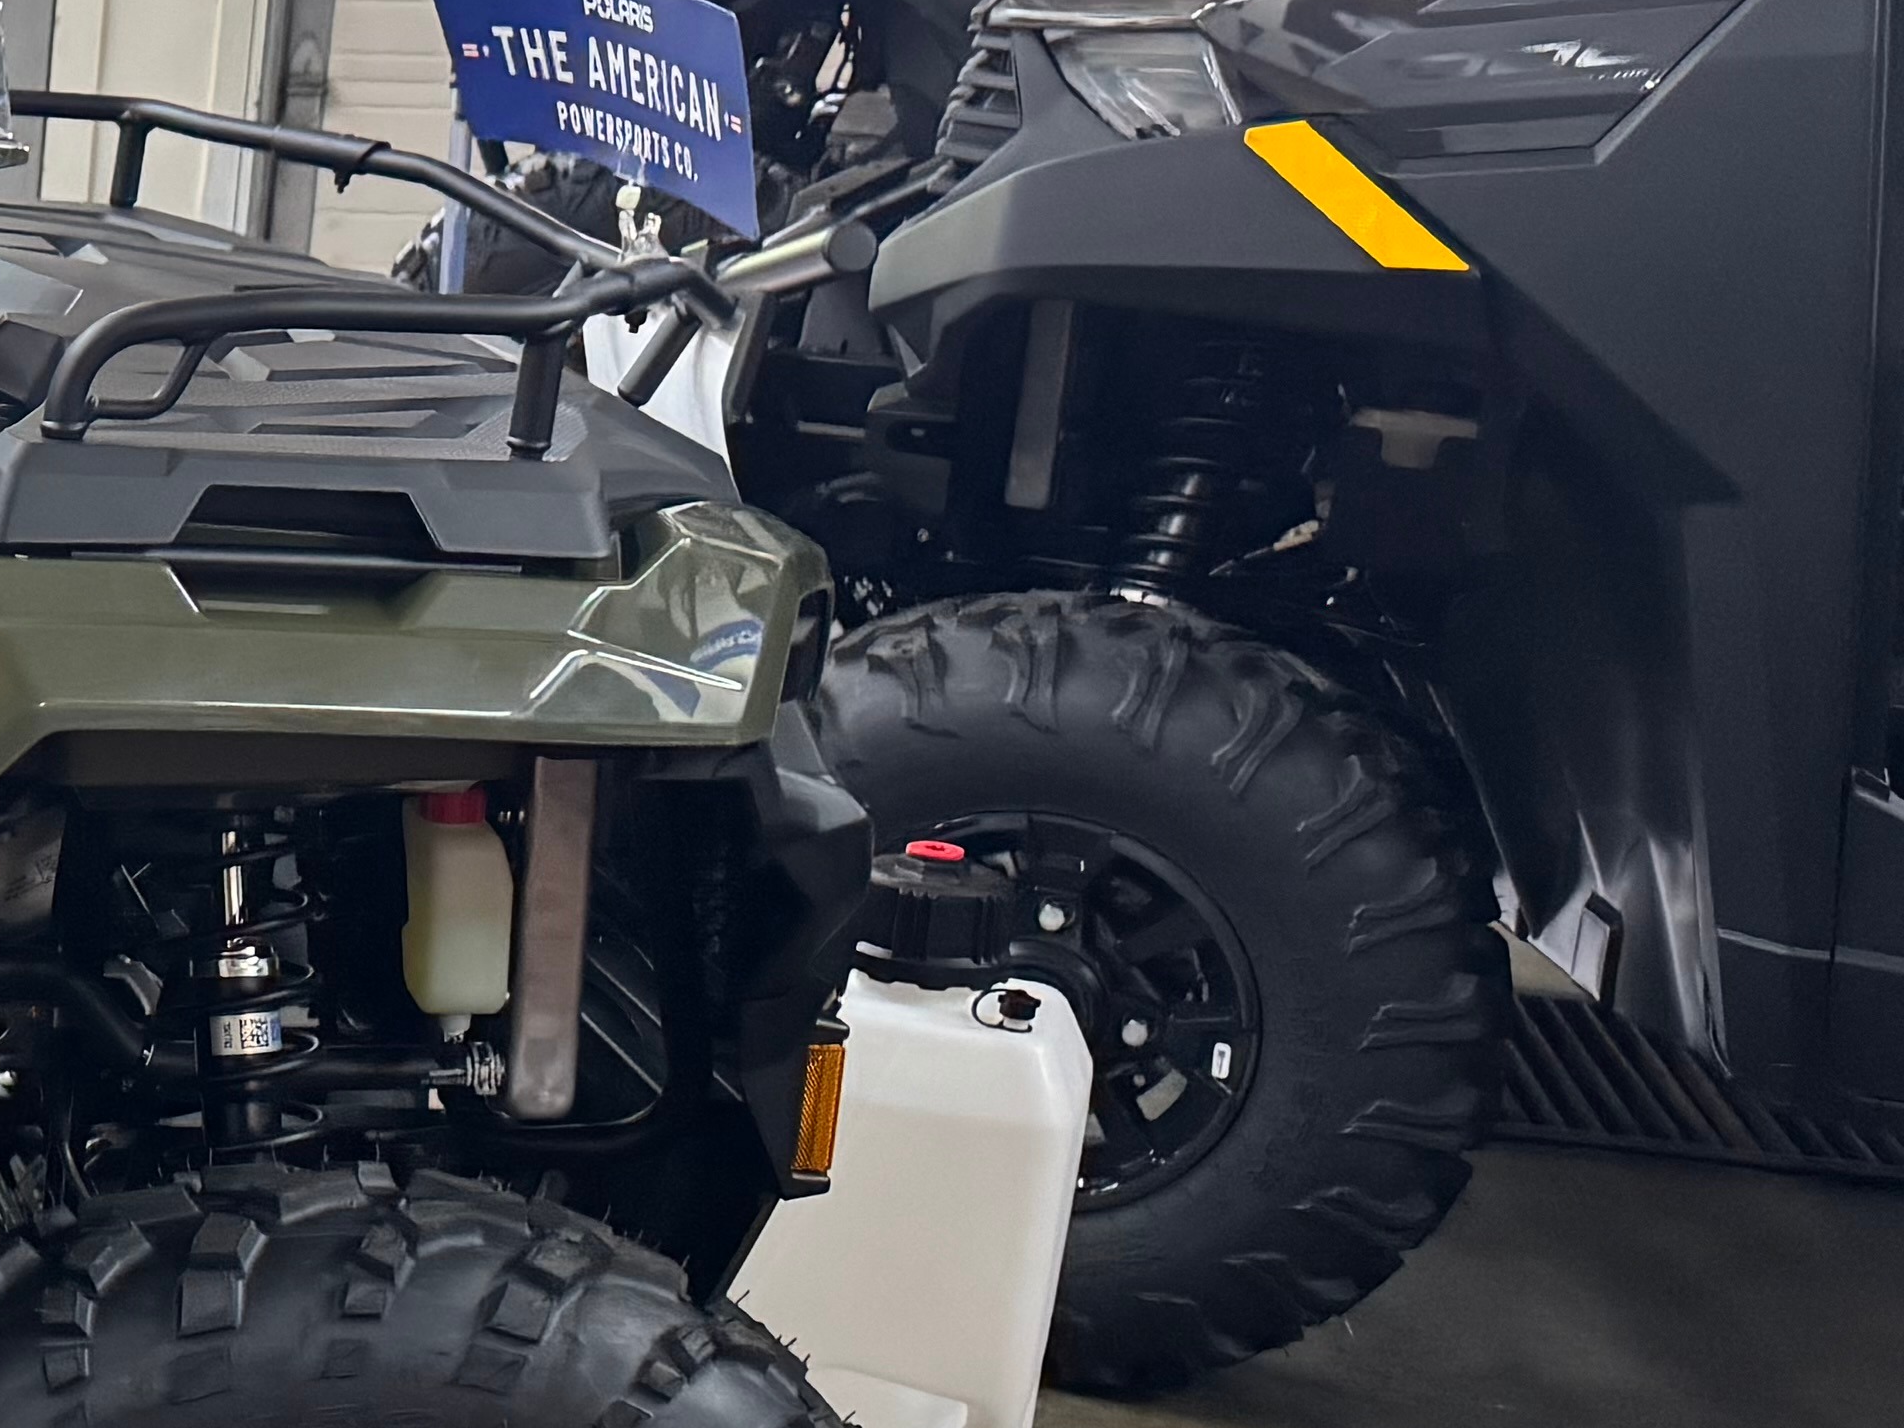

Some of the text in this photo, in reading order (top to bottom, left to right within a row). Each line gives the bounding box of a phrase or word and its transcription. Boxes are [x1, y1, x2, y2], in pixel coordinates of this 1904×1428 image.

[491, 25, 722, 142] THE AMERICAN
[556, 100, 699, 182] POWERSPORTS CO.
